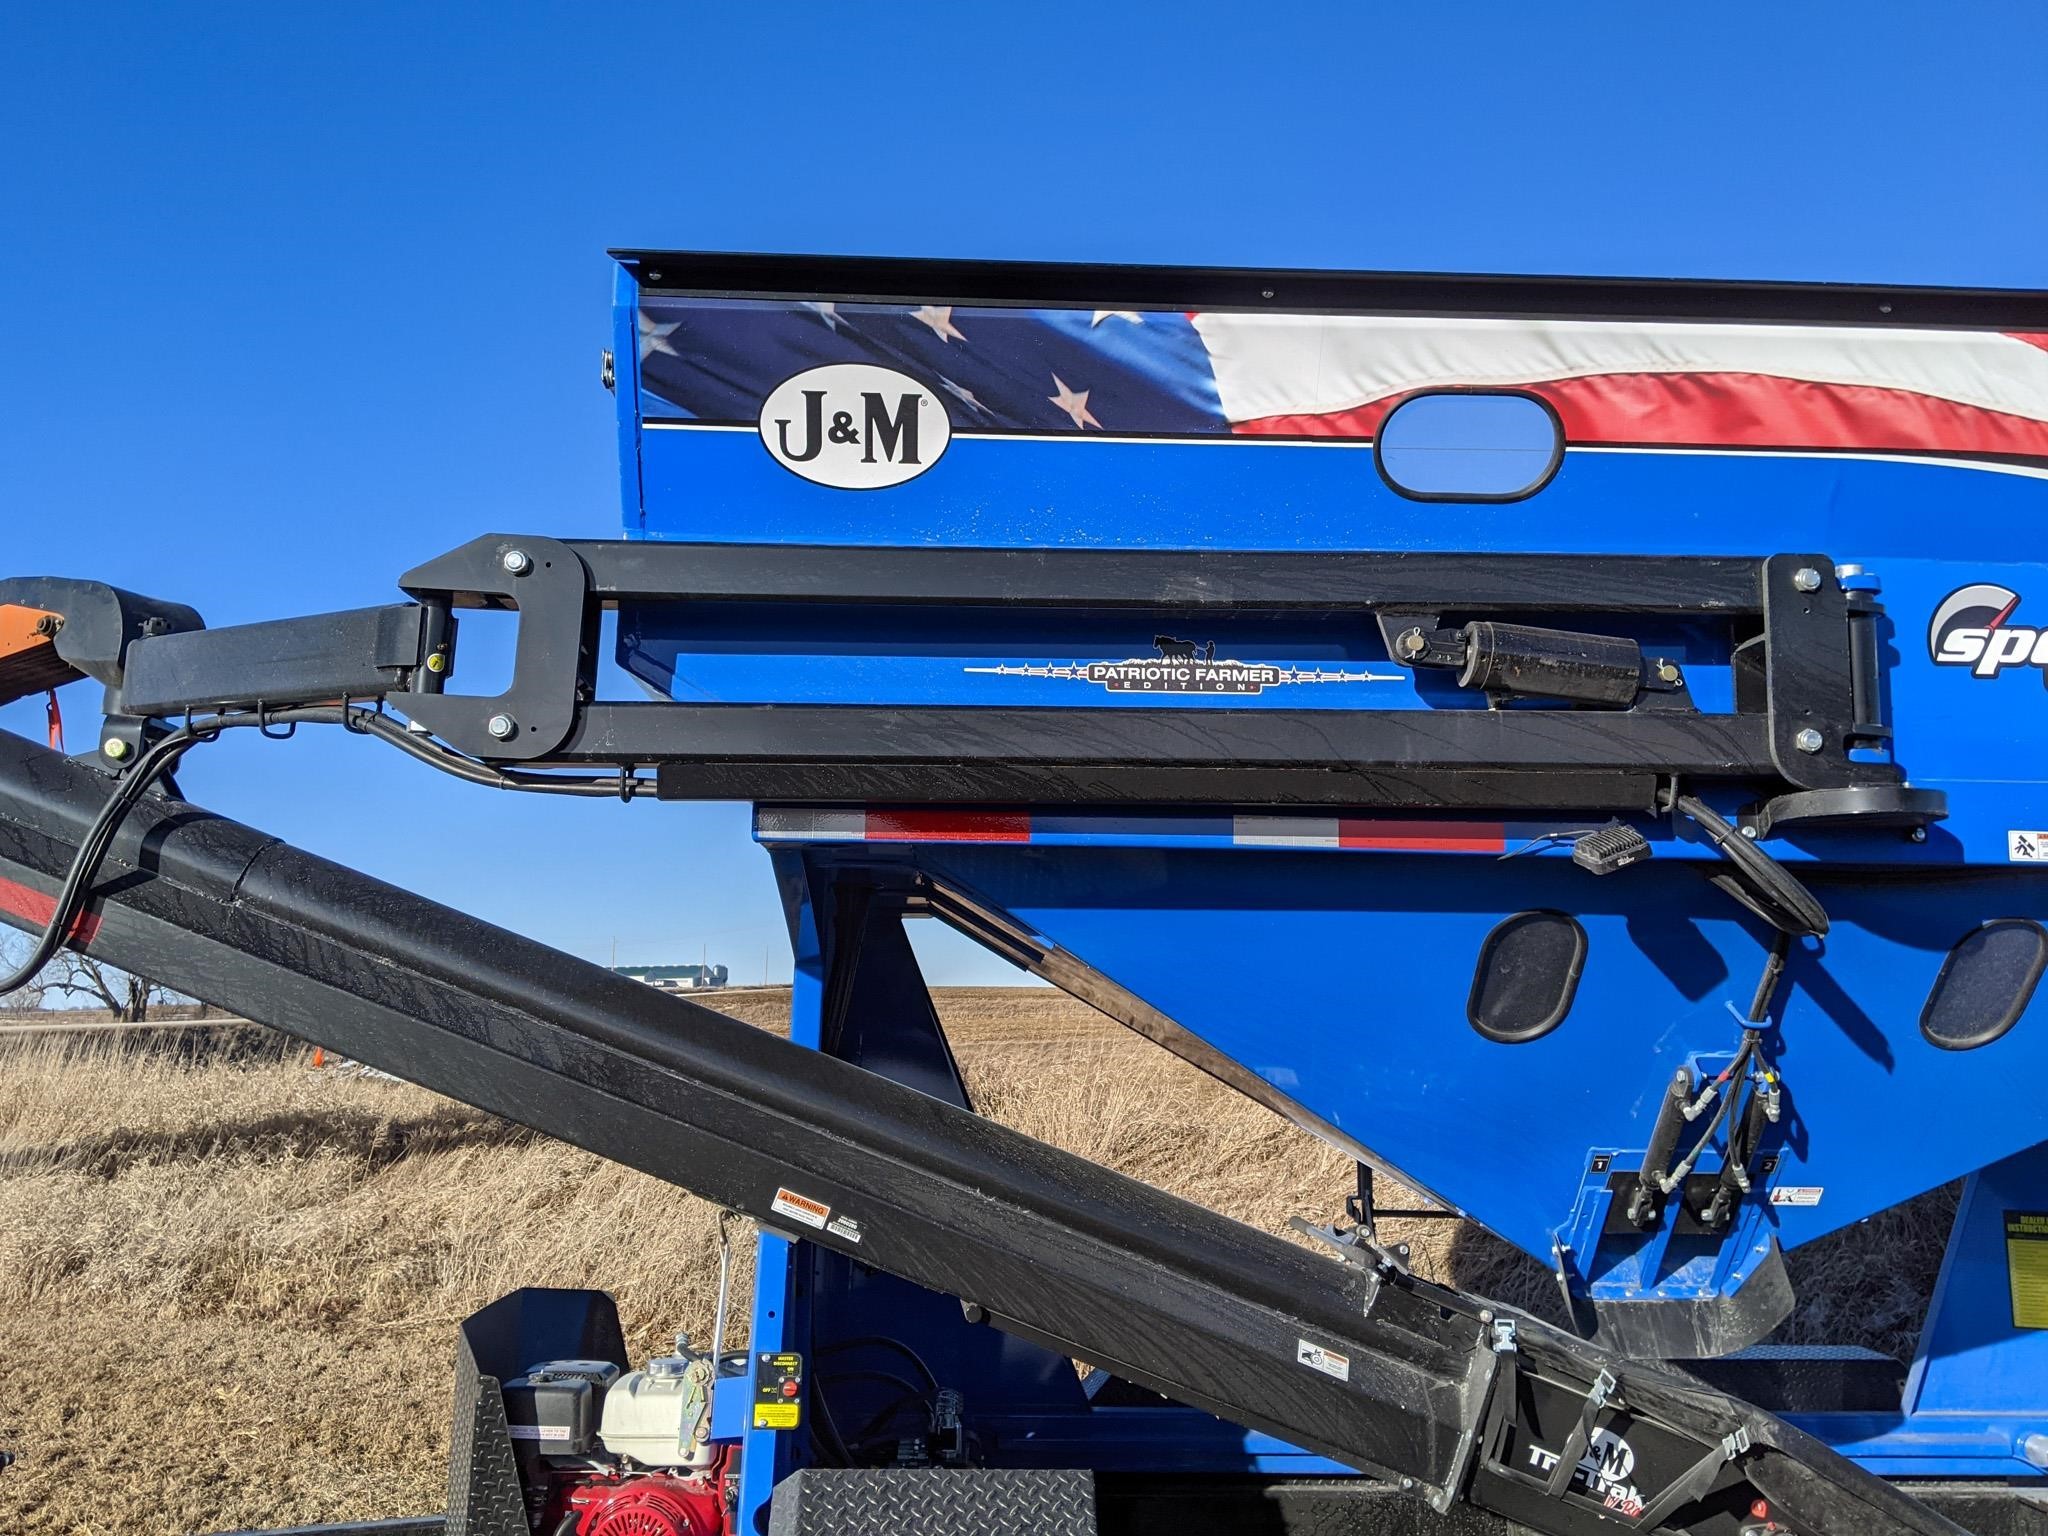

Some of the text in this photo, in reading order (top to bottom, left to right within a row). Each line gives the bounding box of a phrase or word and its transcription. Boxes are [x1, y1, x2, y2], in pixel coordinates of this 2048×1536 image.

[774, 390, 924, 465] J&M
[1093, 666, 1274, 682] PATRIOTIC FARMER
[1123, 681, 1246, 691] EDITION
[1597, 1161, 1604, 1169] 1
[1763, 1161, 1773, 1170] 2
[788, 1194, 825, 1215] WARNING
[1580, 1441, 1631, 1477] &M
[1529, 1444, 1645, 1508] Tr-Trak
